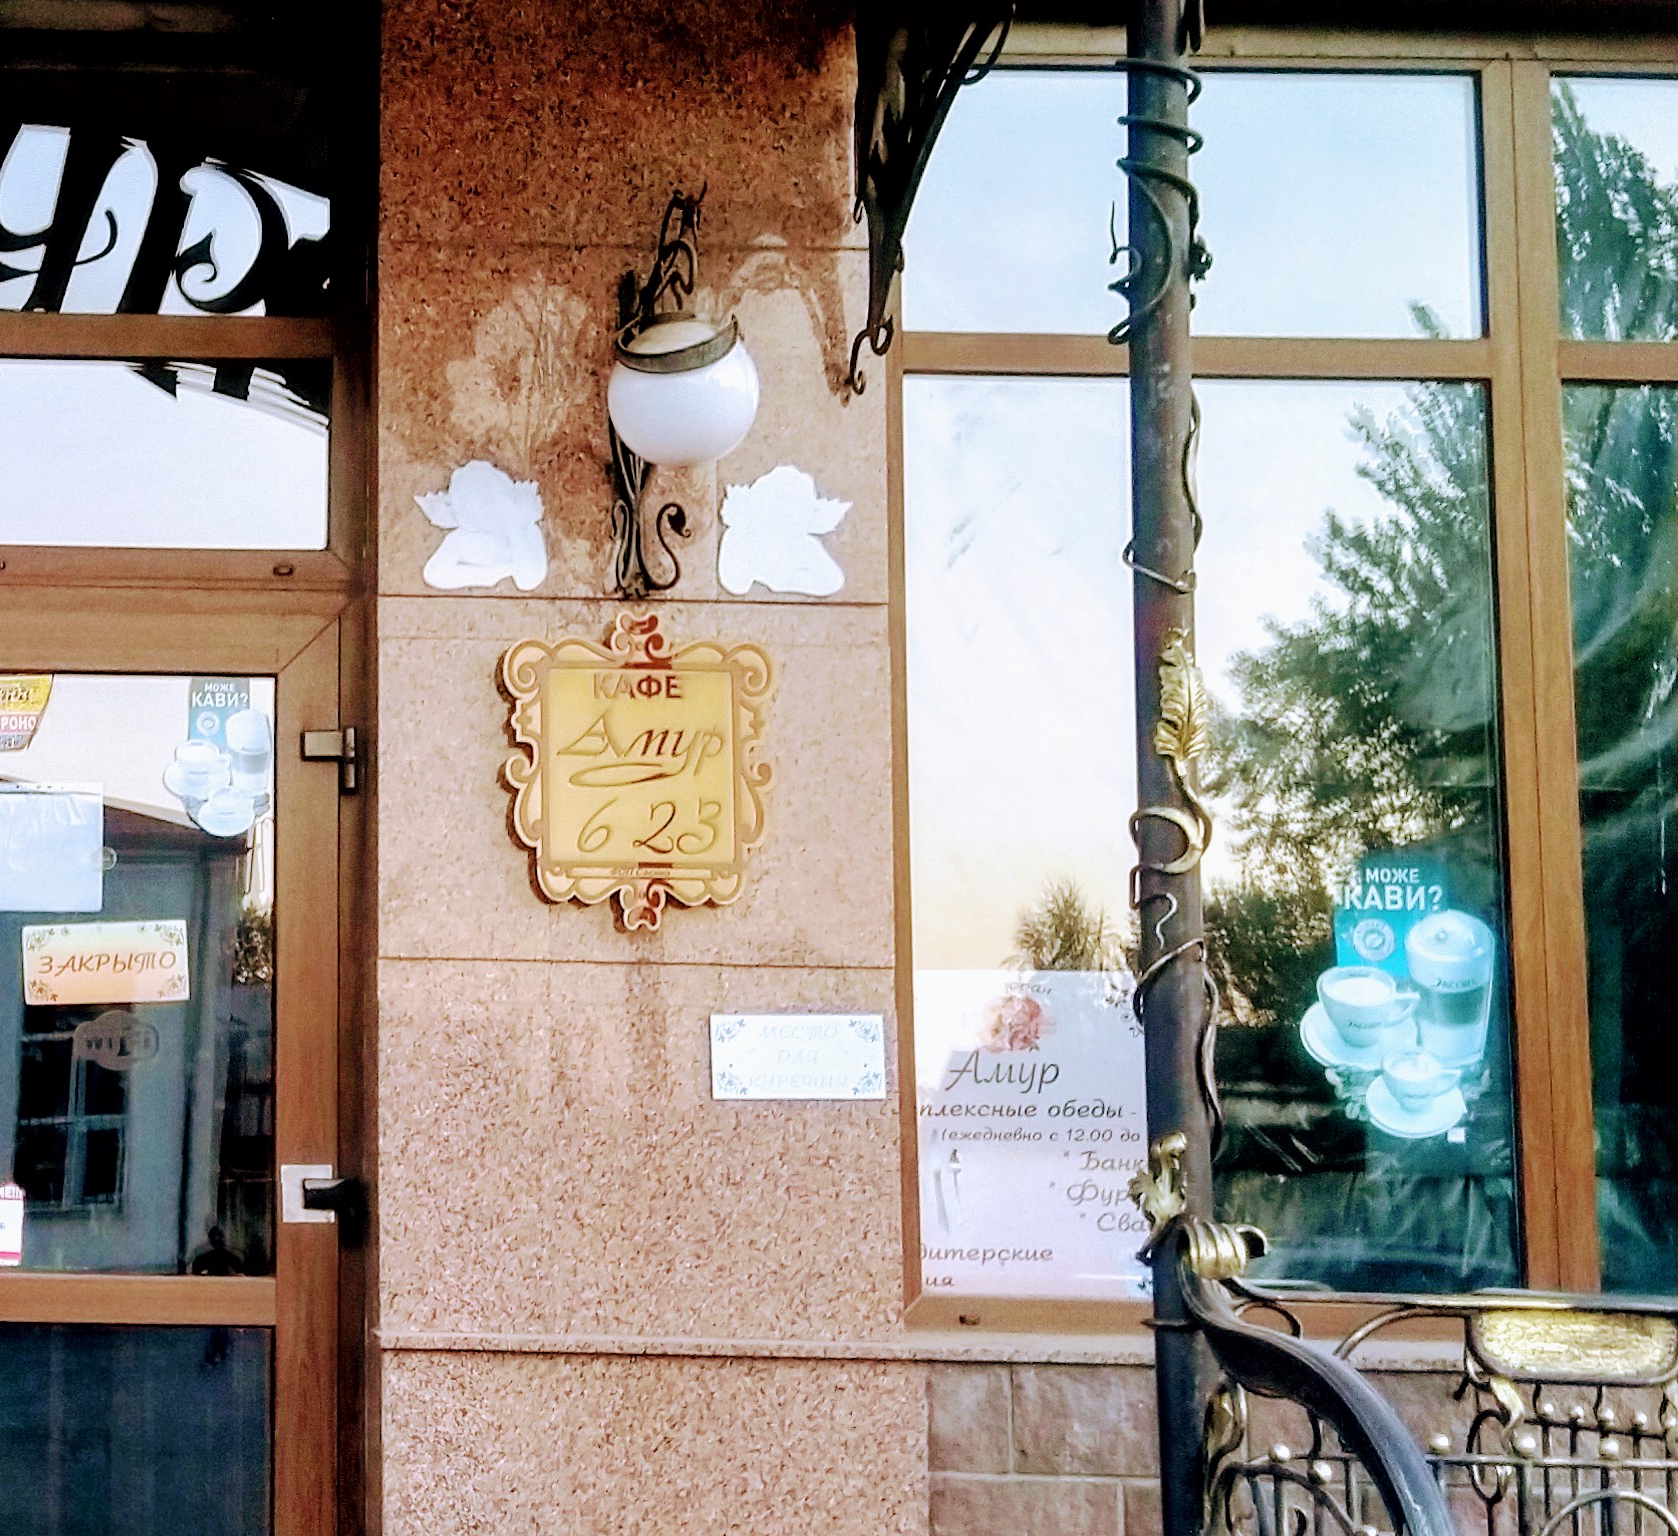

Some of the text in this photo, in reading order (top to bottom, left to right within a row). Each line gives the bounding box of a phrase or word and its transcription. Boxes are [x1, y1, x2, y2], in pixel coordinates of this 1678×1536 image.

[204, 683, 236, 693] МОЖЕ
[593, 675, 683, 699] КАФЕ
[191, 693, 249, 708] КАВИ?
[1366, 868, 1421, 884] МОЖЕ
[1344, 885, 1444, 911] КАВИ?
[38, 951, 177, 977] ЗАКРЫТО
[945, 1050, 1060, 1094] Амур
[1048, 1099, 1123, 1119] обеды
[1049, 1131, 1058, 1141] с
[1067, 1129, 1113, 1142] 12.00
[1120, 1128, 1140, 1142] до
[1097, 1212, 1146, 1232] Сва
